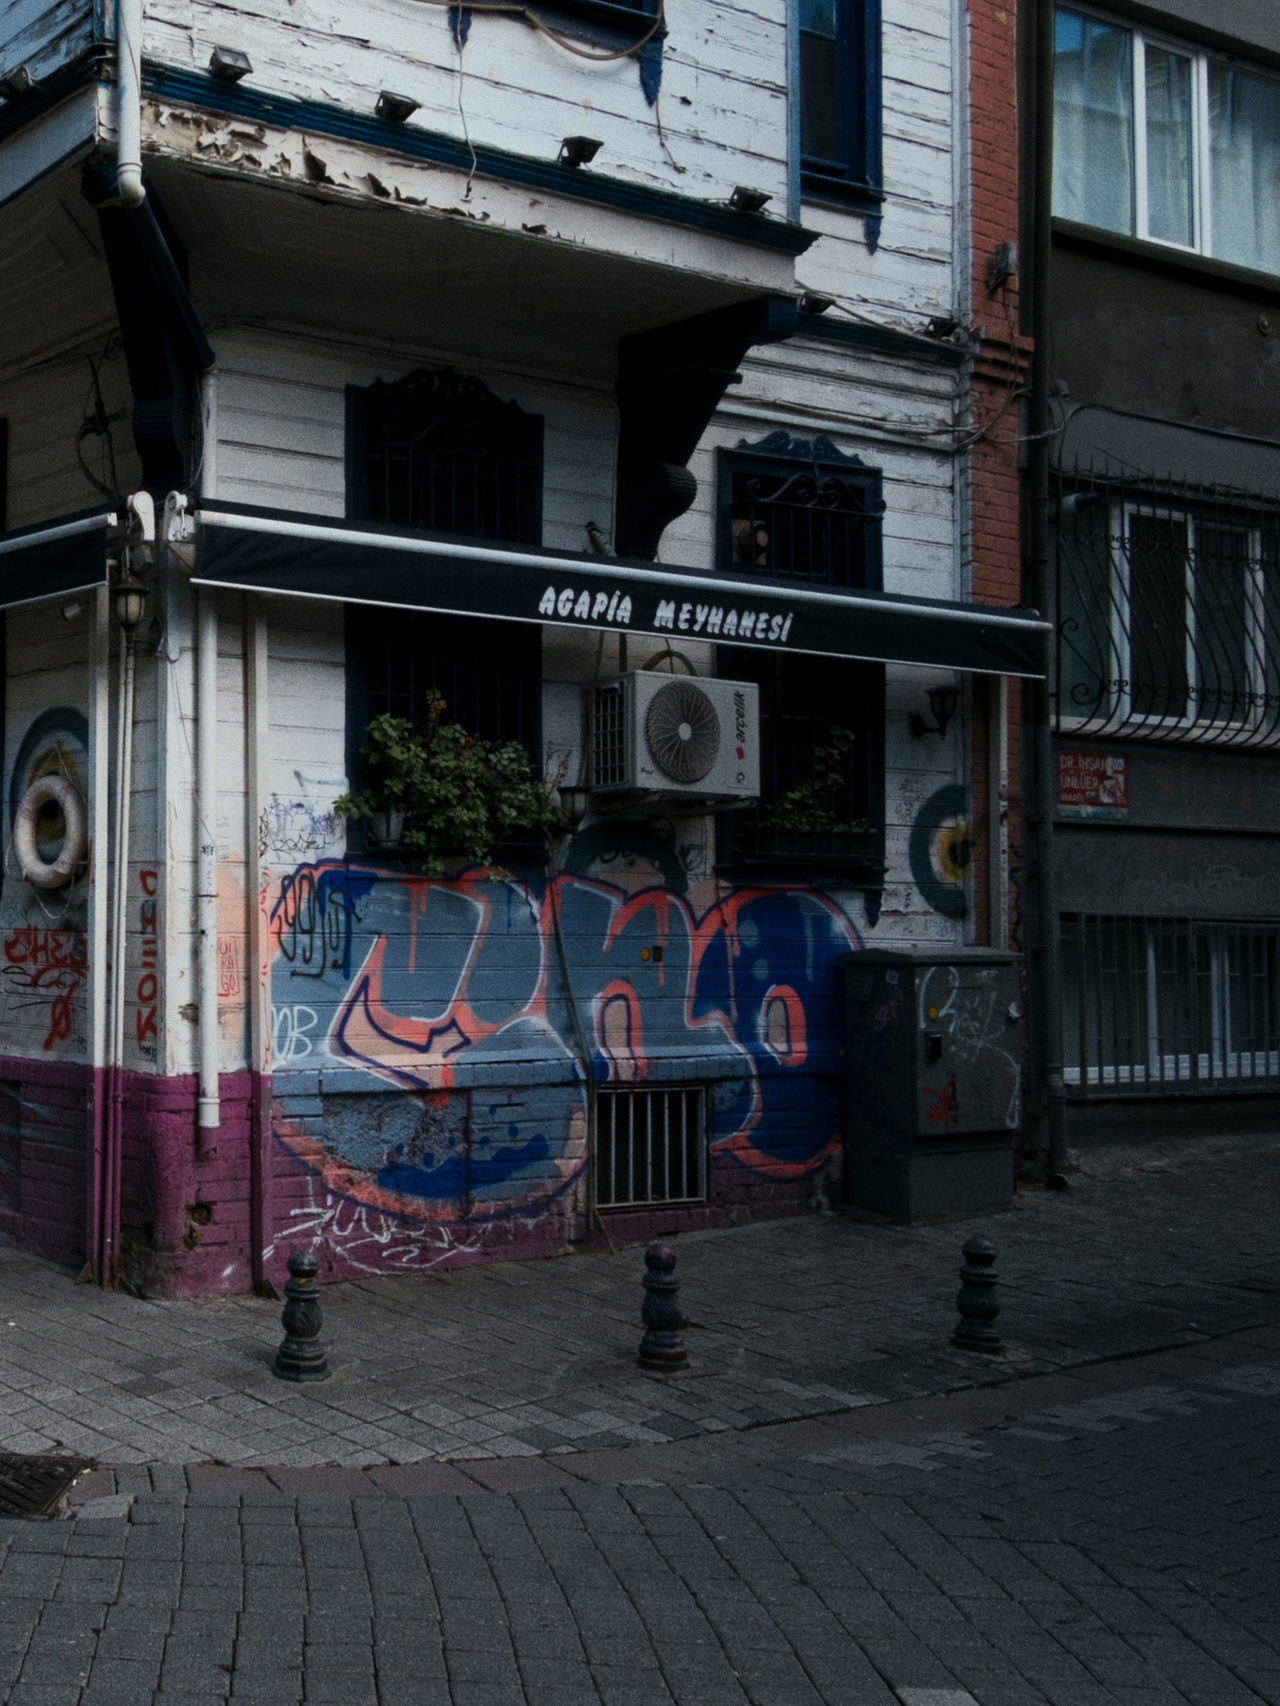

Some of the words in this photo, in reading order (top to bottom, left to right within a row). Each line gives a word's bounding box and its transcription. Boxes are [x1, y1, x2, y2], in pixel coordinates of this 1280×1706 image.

[538, 585, 633, 624] AGAPİA
[653, 598, 795, 642] MEYHANESİ
[733, 690, 747, 743] arçelik
